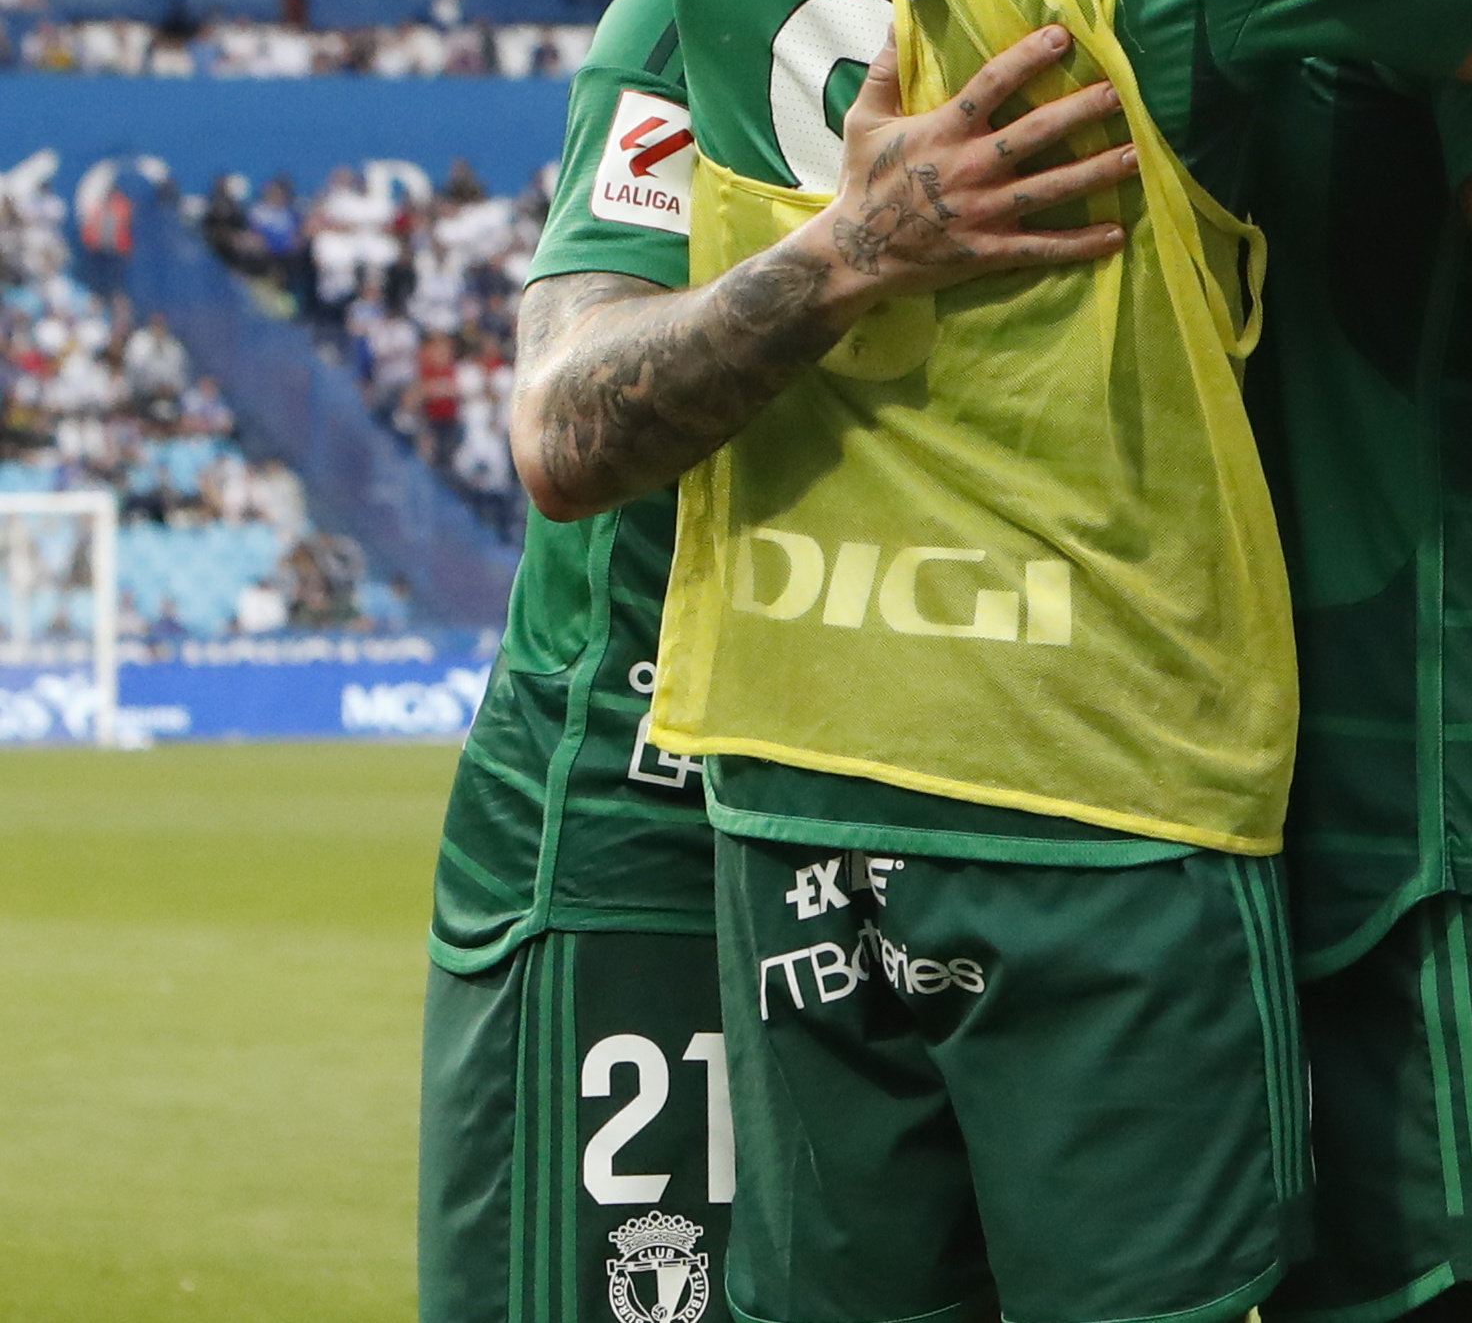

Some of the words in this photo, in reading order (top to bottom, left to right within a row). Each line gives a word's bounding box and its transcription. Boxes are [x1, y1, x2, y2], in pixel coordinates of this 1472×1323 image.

[603, 181, 681, 215] LALIGA
[731, 526, 1072, 646] DIGI
[581, 1033, 737, 1205] 21
[637, 1246, 676, 1262] CLUB
